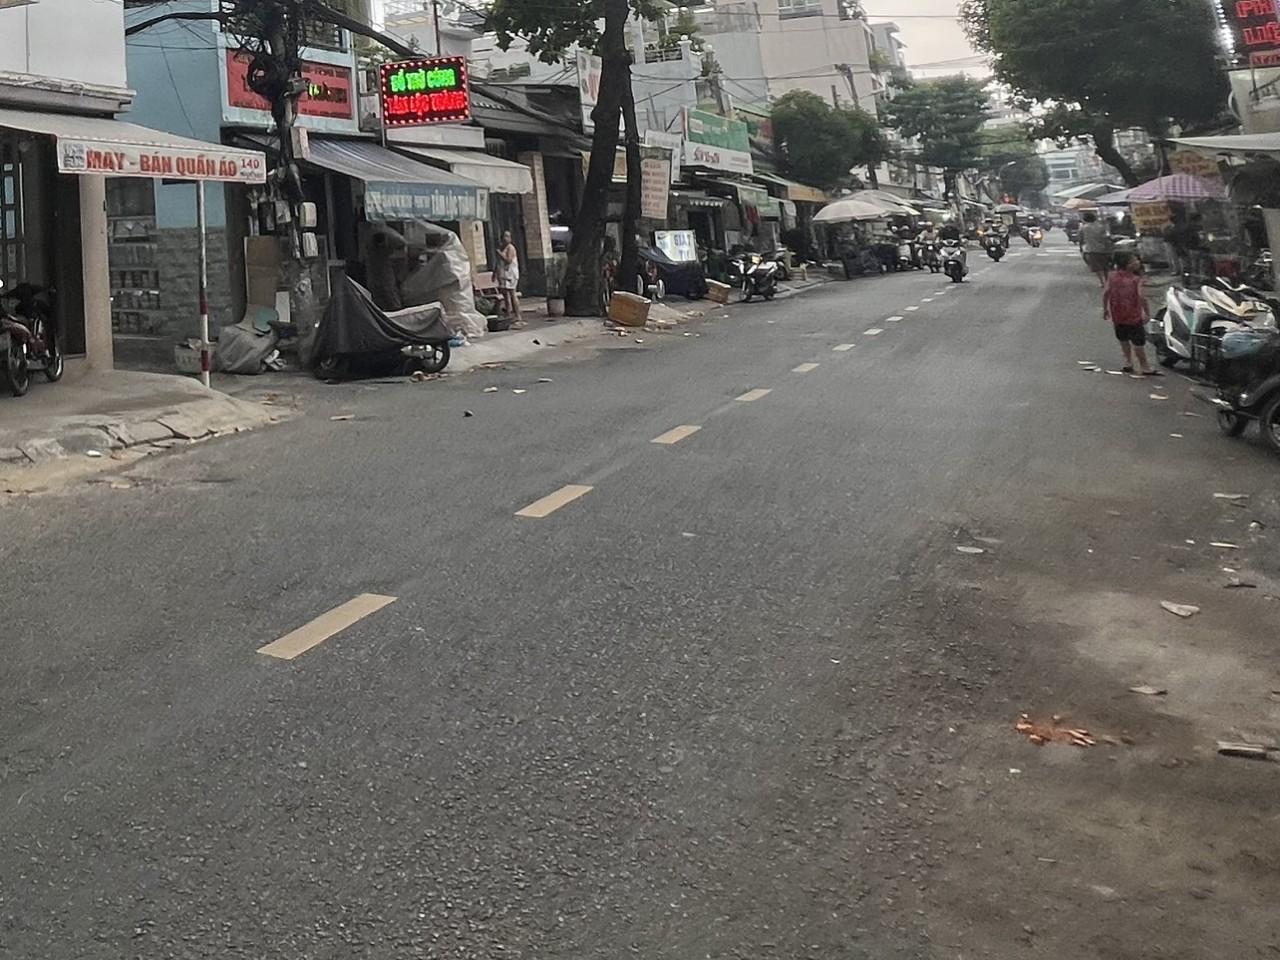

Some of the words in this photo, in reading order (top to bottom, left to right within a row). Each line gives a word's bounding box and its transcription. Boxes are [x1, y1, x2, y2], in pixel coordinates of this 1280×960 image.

[86, 149, 127, 170] MAY
[139, 151, 173, 174] BÁN
[218, 155, 237, 177] ÁO
[240, 157, 260, 169] 140
